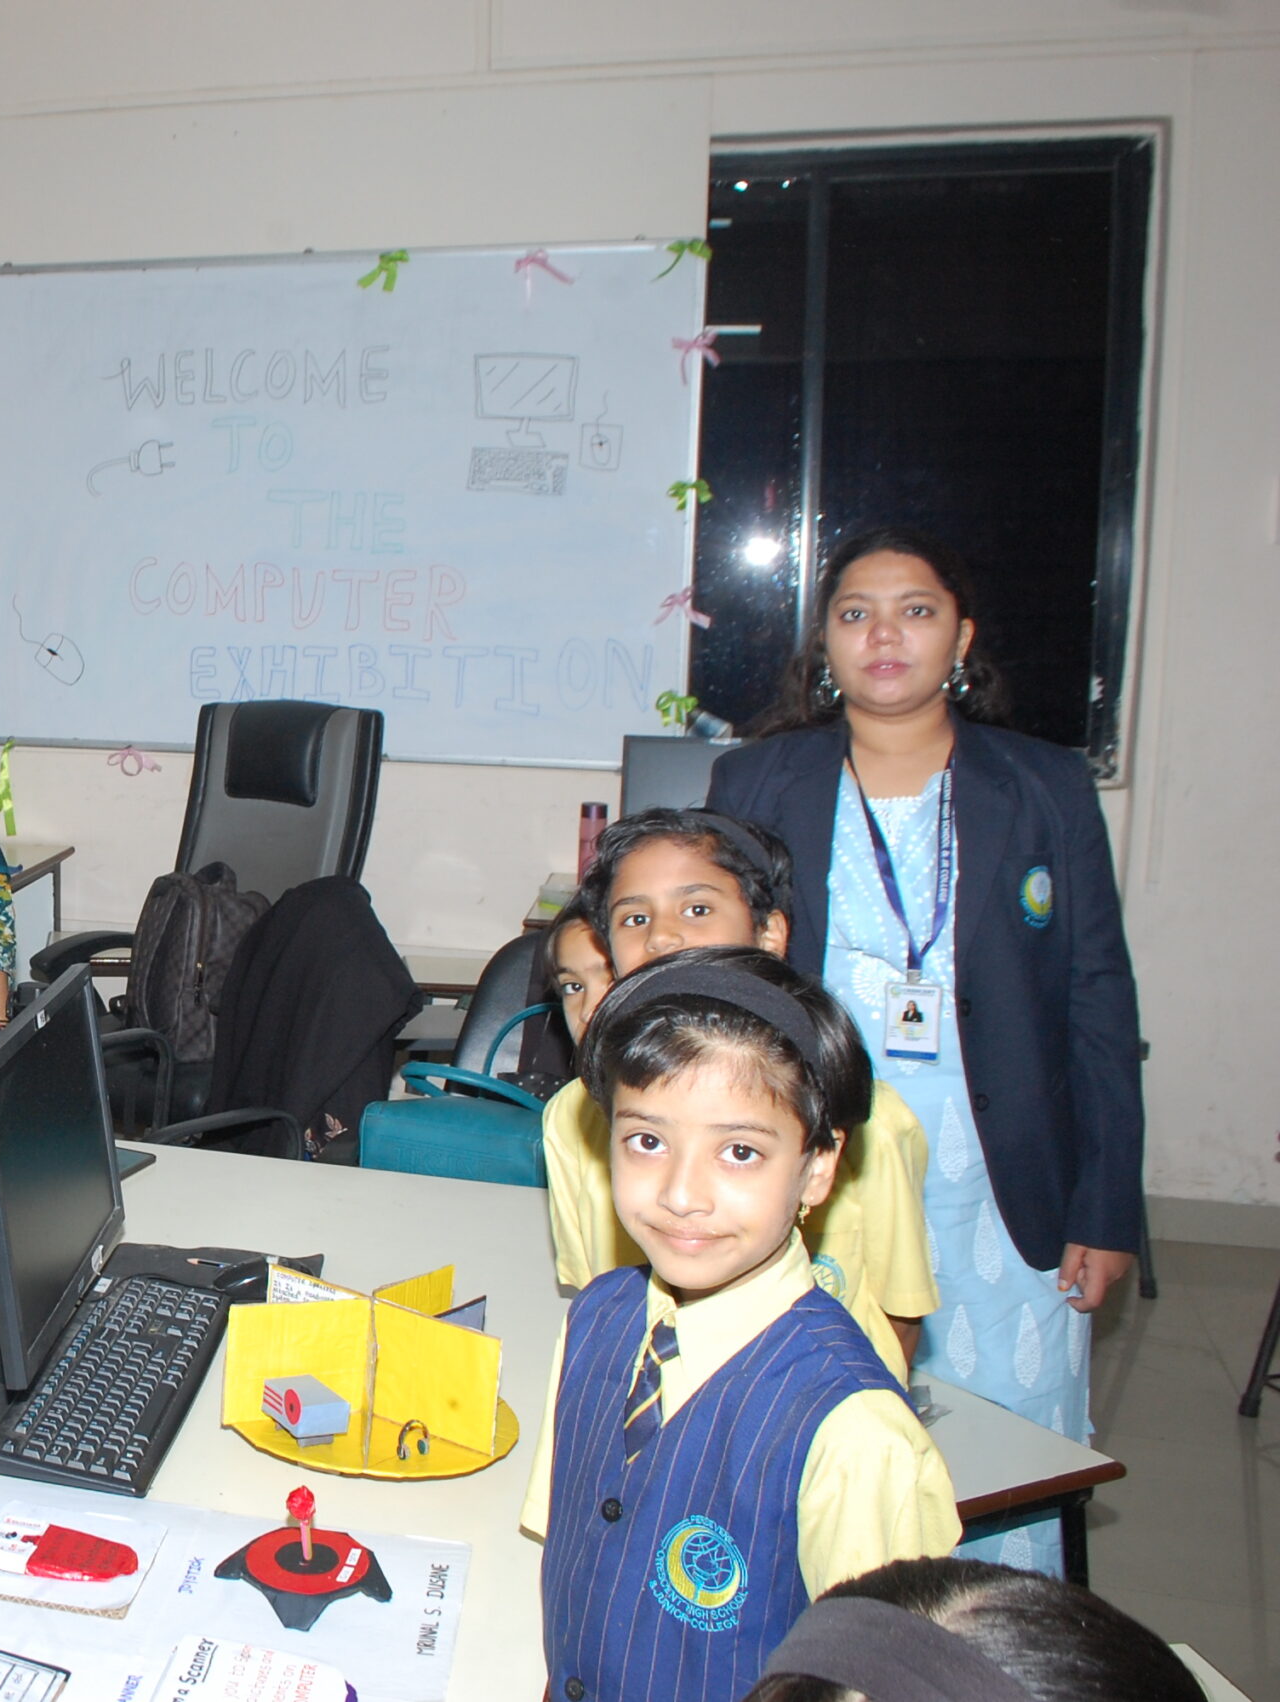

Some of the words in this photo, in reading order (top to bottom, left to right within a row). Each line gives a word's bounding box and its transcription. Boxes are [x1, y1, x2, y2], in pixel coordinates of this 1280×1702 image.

[106, 345, 389, 411] WELCOME
[211, 414, 294, 474] TO
[267, 489, 406, 554] THE
[128, 556, 467, 642] COMPUTER
[189, 637, 655, 716] EXHIBITION
[941, 820, 951, 849] SCHOOL
[938, 869, 950, 903] COLLEGE
[653, 1589, 690, 1623] JUNIOR
[690, 1615, 740, 1632] COLLEGE
[655, 1550, 688, 1609] CRESCENT
[685, 1603, 709, 1620] HIGH
[710, 1591, 749, 1620] SCHOOL
[179, 1638, 214, 1686] Scanner
[293, 1664, 319, 1702] MPUTER
